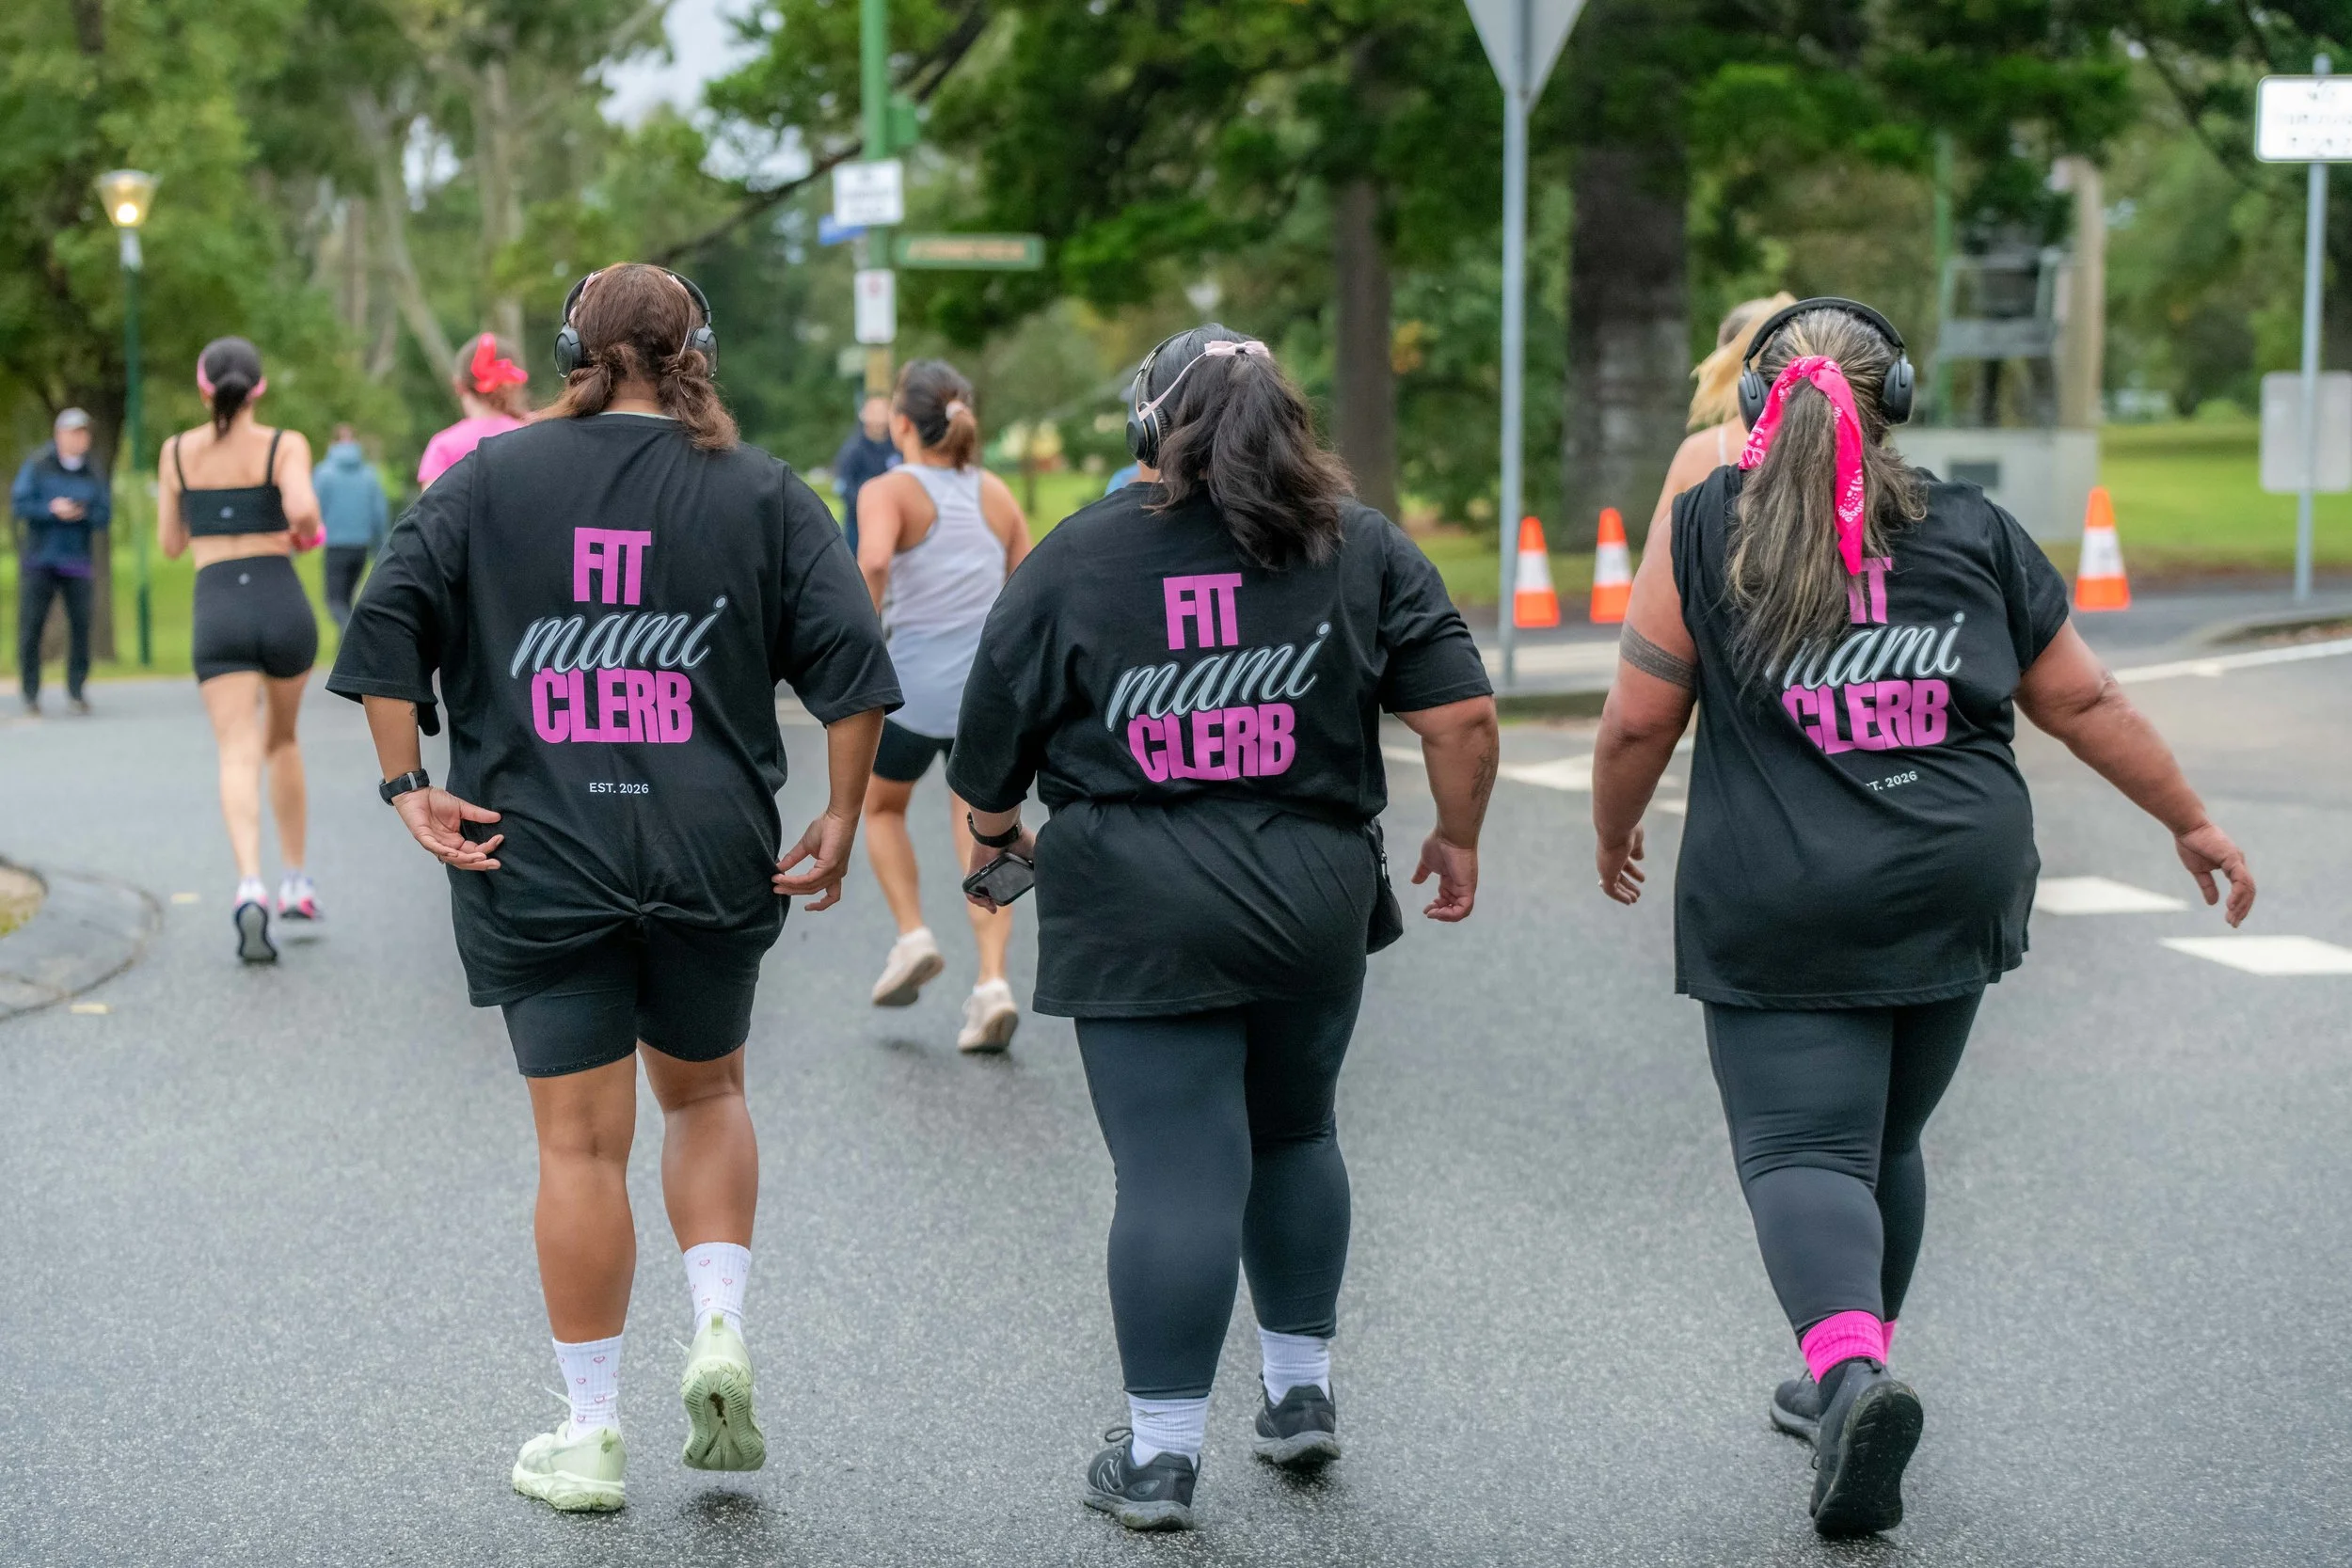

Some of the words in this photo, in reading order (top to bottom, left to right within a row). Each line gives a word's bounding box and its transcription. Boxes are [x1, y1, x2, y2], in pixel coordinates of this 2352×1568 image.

[573, 527, 651, 605] FIT
[1846, 557, 1892, 624] IT
[511, 595, 727, 678] mami
[1163, 573, 1242, 650] FIT
[531, 667, 693, 743] CLERB
[1105, 622, 1331, 731] mami
[1127, 703, 1295, 783] CLERB
[1782, 679, 1949, 754] CLERB
[589, 783, 616, 793] EST.
[619, 783, 649, 794] 2026
[1884, 770, 1918, 788] 2026
